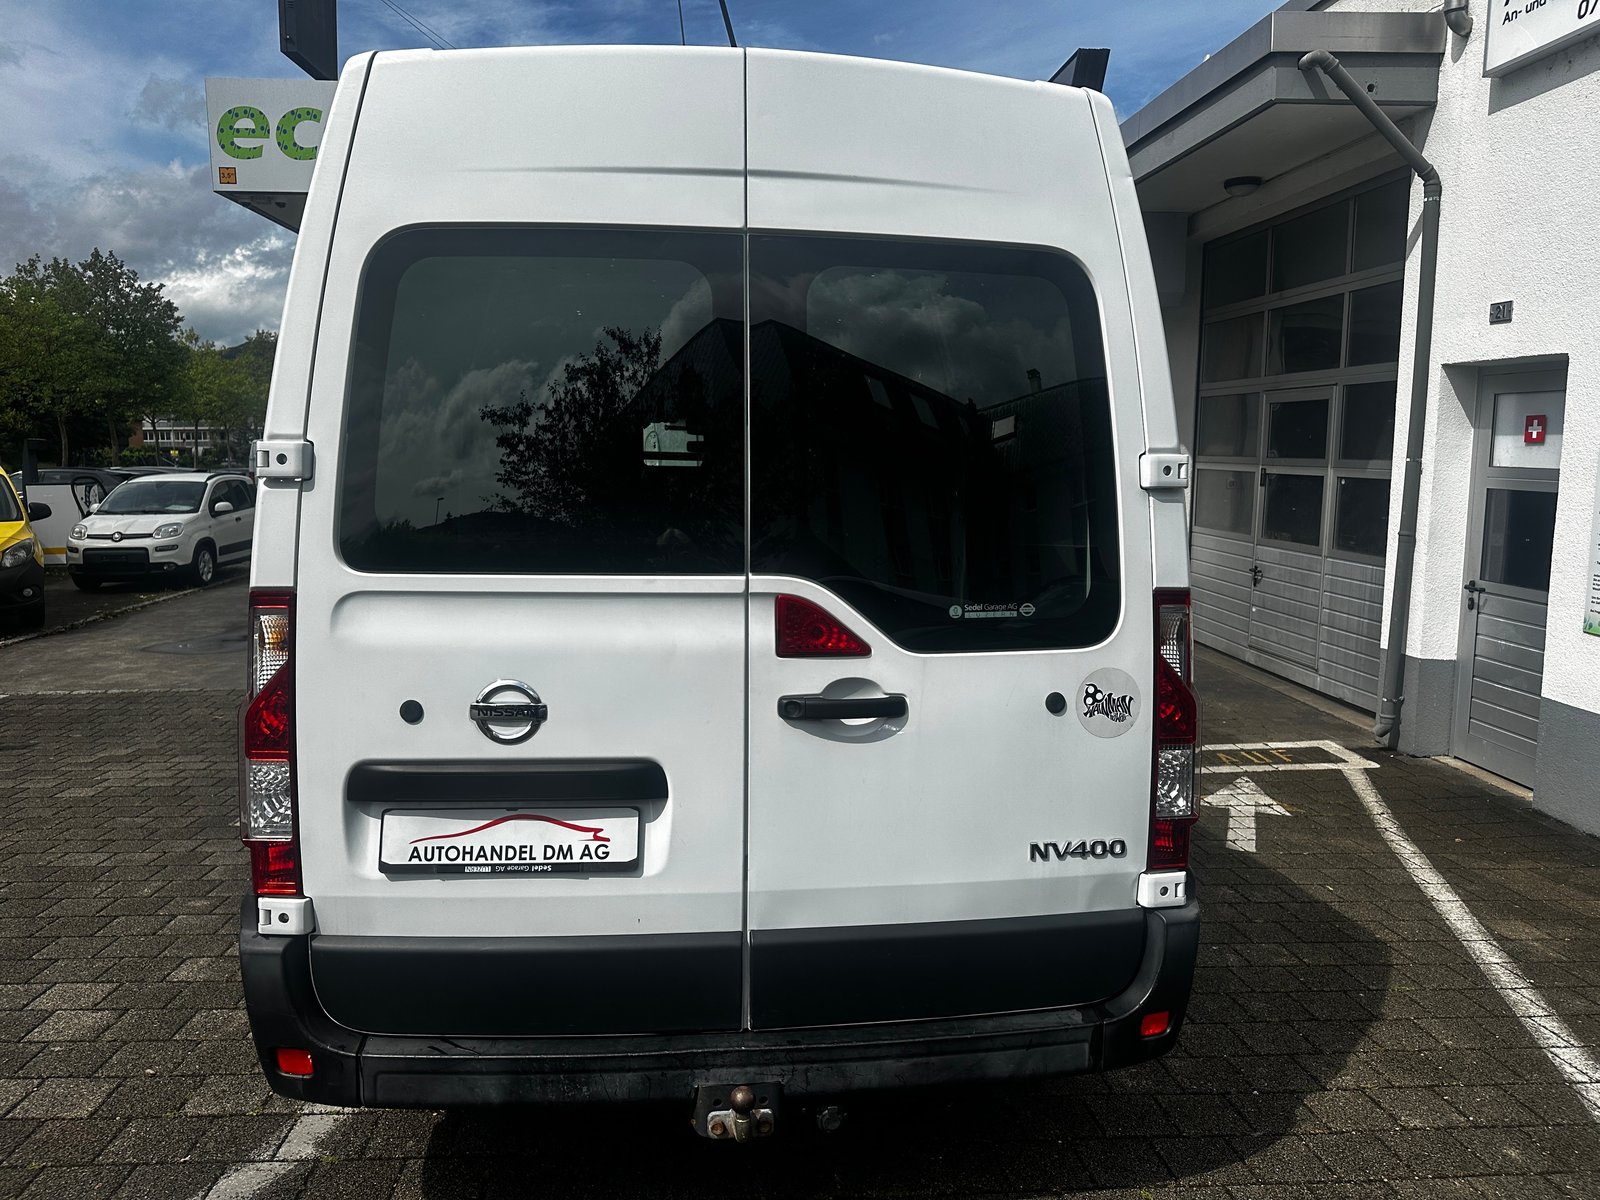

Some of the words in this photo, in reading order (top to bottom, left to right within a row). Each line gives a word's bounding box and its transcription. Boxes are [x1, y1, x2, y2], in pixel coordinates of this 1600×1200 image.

[1502, 10, 1522, 26] An-
[216, 105, 323, 161] ec
[1495, 304, 1506, 320] 21
[964, 603, 983, 611] Sedel
[983, 603, 1007, 612] Garage
[1007, 602, 1018, 610] AG
[477, 707, 538, 718] NISSAN
[408, 844, 537, 862] AUTOHANDEL
[543, 844, 574, 861] DM
[579, 844, 610, 860] AG
[1029, 838, 1128, 862] NV400
